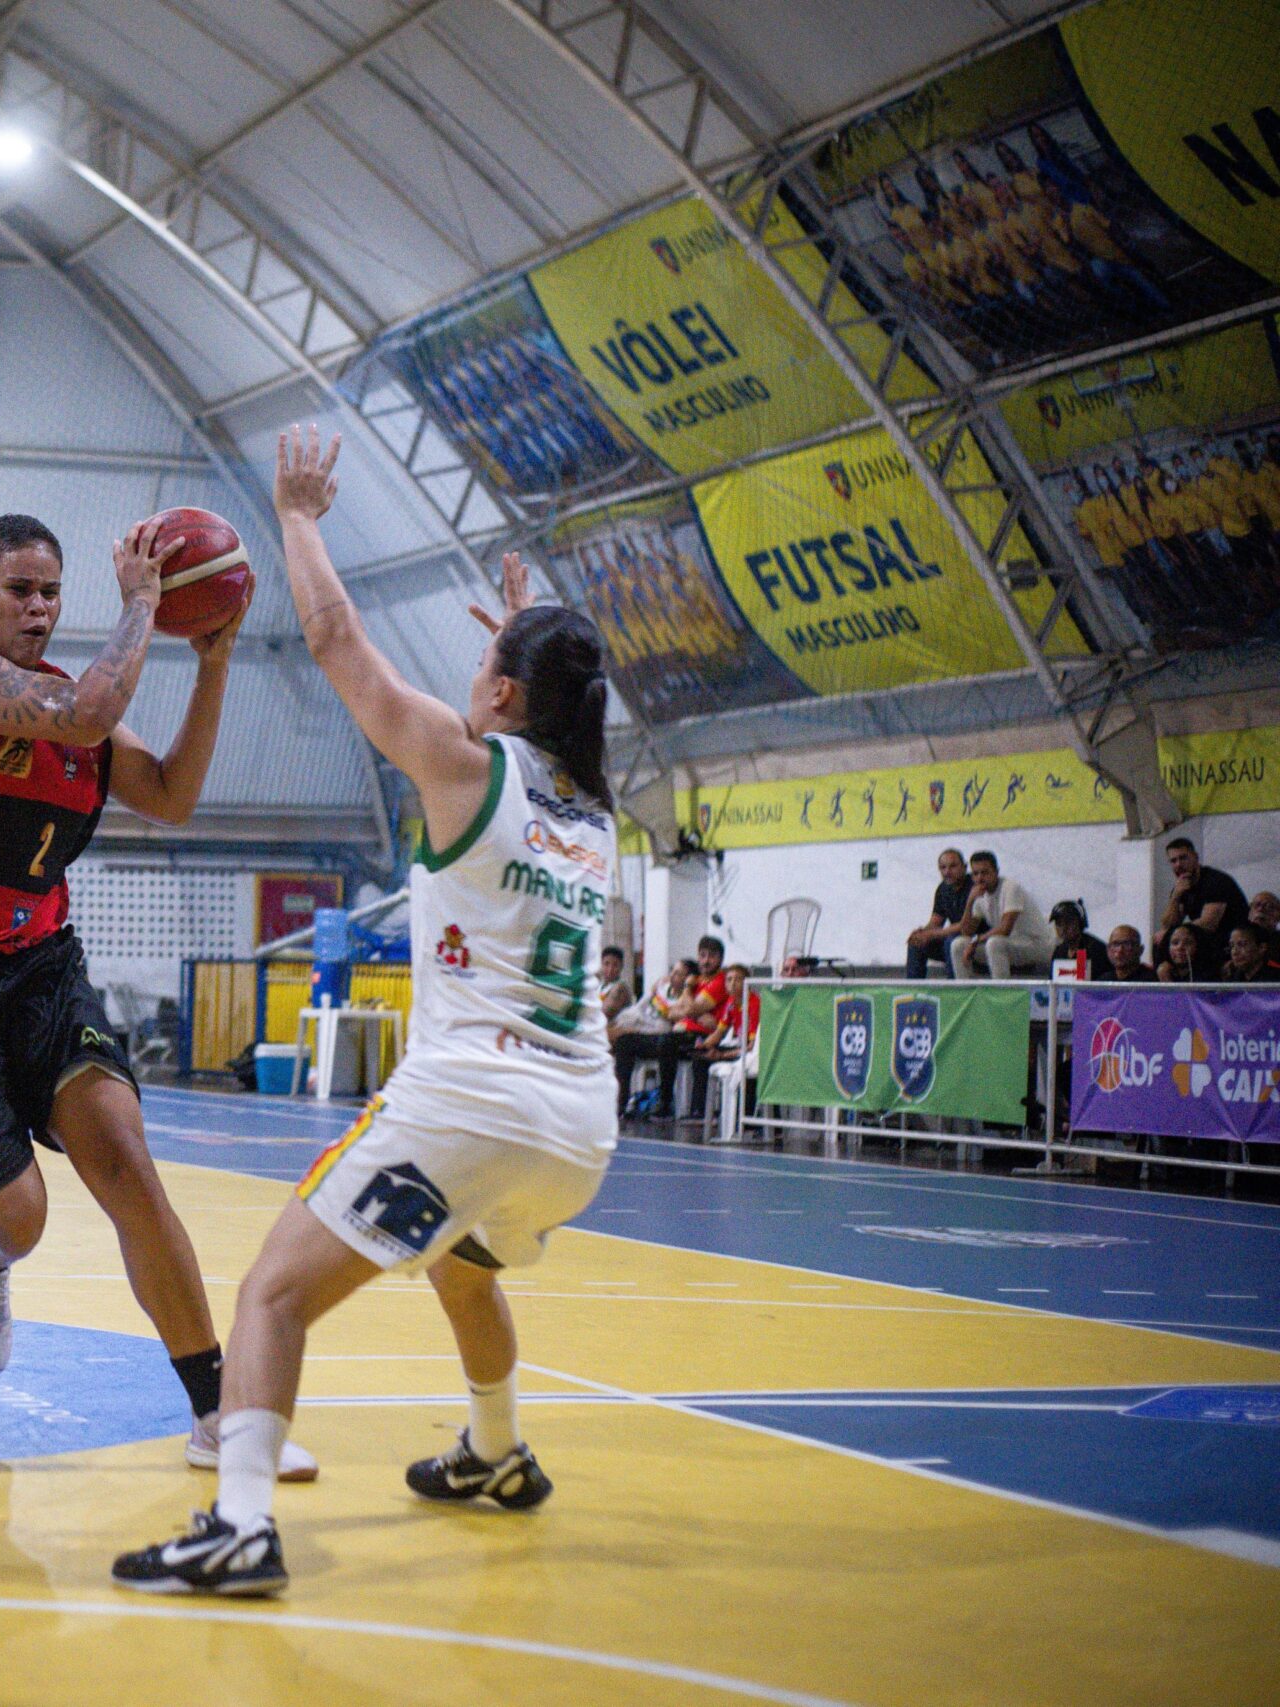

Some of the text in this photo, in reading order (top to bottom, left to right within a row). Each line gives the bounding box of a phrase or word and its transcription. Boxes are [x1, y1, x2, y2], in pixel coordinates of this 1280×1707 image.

[590, 301, 740, 395] VÔLEI
[642, 373, 771, 436] MASCULINO
[744, 517, 943, 612] FUTSAL
[785, 604, 921, 655] MASCULINO
[28, 822, 56, 879] 2
[526, 914, 593, 1036] 9
[900, 1026, 933, 1060] CBB
